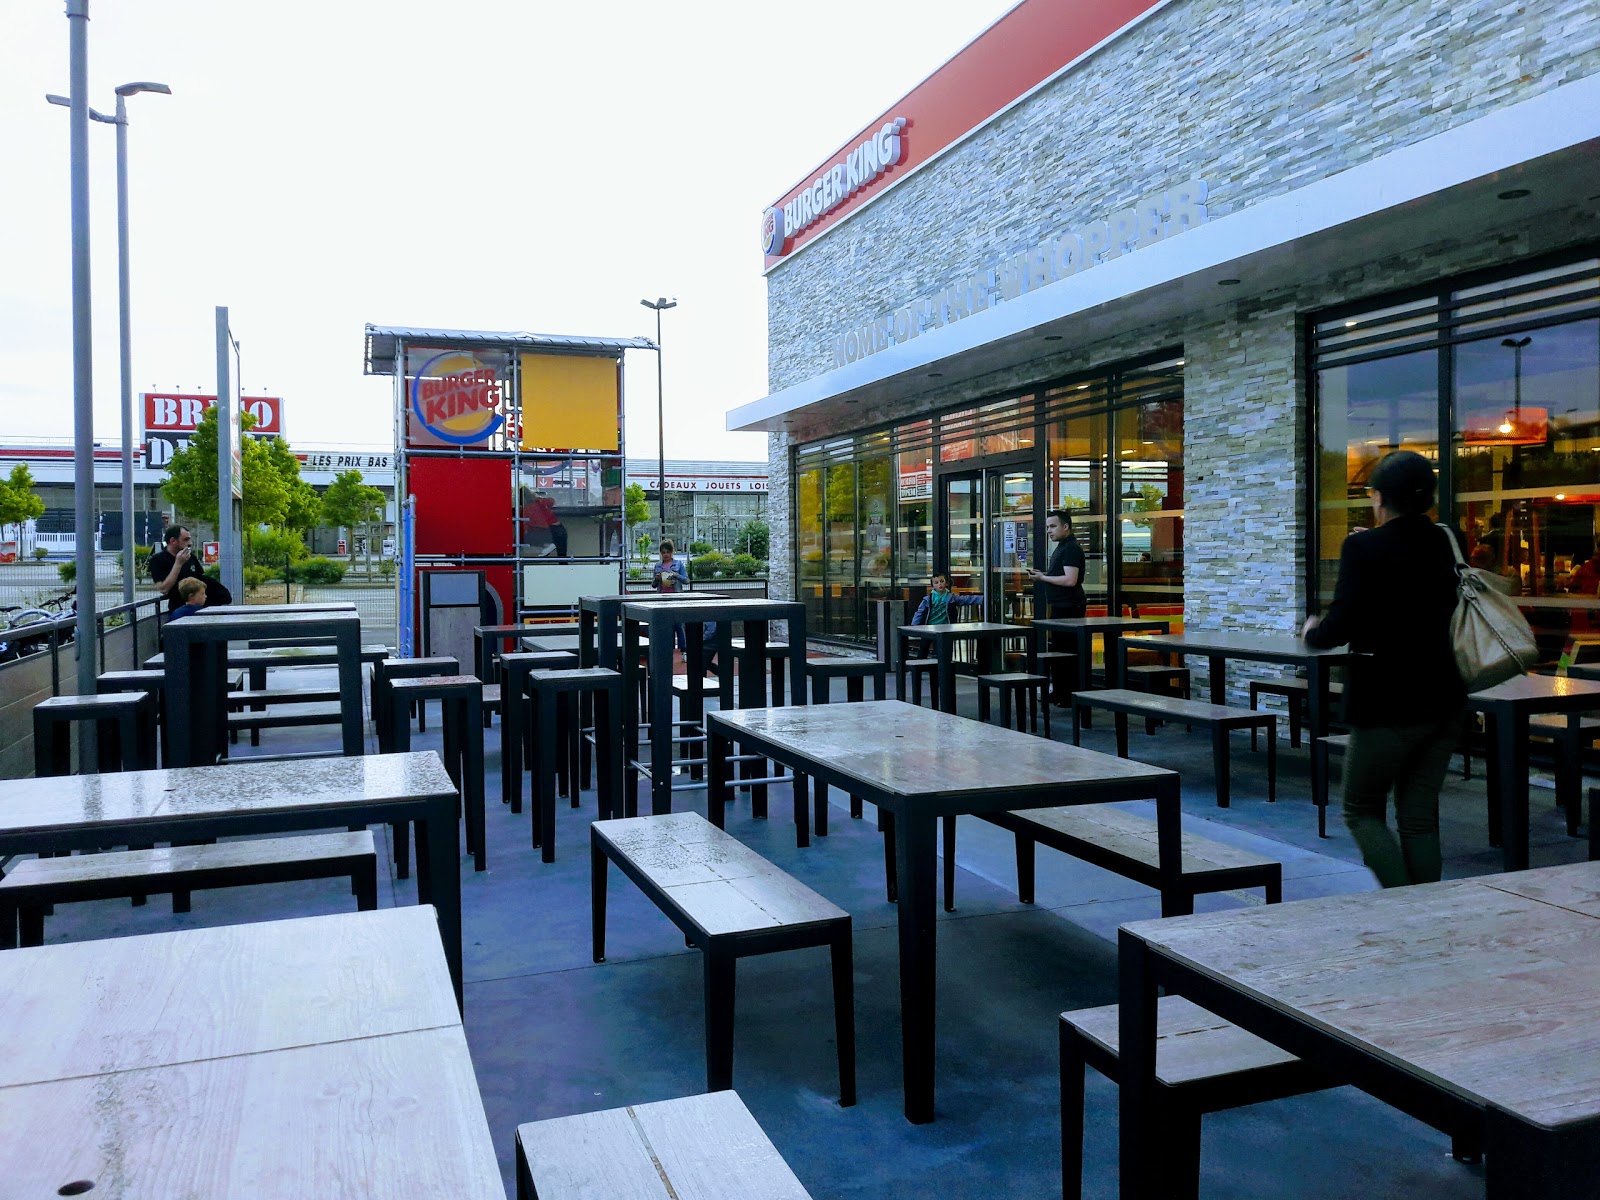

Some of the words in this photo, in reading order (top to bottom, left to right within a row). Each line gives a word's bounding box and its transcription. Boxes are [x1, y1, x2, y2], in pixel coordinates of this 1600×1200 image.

[784, 163, 847, 238] BURGER
[847, 122, 901, 193] KING
[832, 314, 895, 369] HOME
[894, 299, 933, 344] OF
[930, 270, 996, 331] THE
[1000, 179, 1209, 301] WHOPPER
[421, 368, 496, 400] BURGER
[153, 398, 273, 428] BRO
[426, 386, 500, 425] KING
[312, 455, 332, 466] LES
[337, 455, 362, 467] PRIX
[367, 456, 388, 467] BAS
[705, 482, 741, 490] JOUETS
